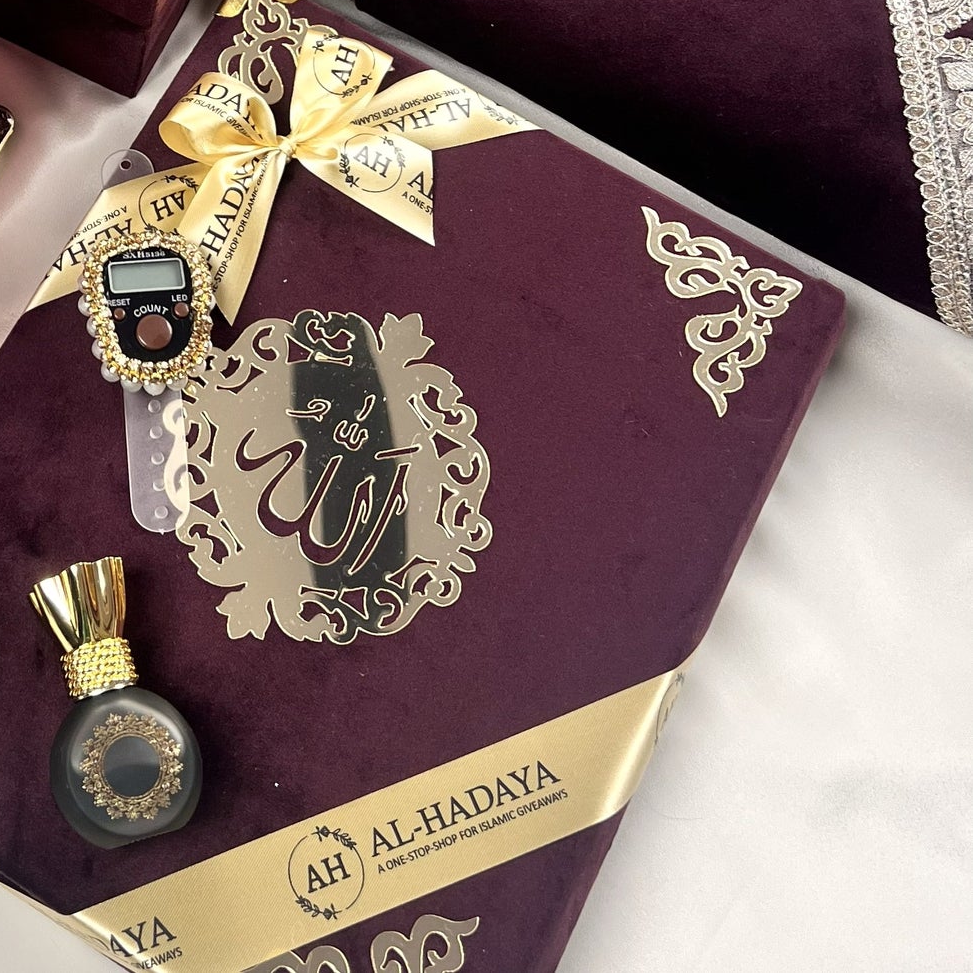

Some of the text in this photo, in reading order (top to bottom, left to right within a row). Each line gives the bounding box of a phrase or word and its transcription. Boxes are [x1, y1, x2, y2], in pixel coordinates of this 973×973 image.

[331, 44, 359, 86] AH
[194, 98, 227, 118] ISLAMIC
[382, 108, 398, 119] FOR
[400, 89, 460, 112] ONE-STOP-SHOP
[353, 146, 392, 178] AH
[150, 190, 187, 222] AH
[401, 191, 408, 199] A
[236, 220, 248, 237] FOR
[244, 186, 259, 220] ISLAMIC
[107, 298, 131, 306] RESET
[133, 304, 169, 317] COUNT
[171, 294, 188, 302] LED
[371, 760, 561, 858] AL-HADAYA
[377, 788, 568, 874] A ONE-STOP-SHOP FOR ISLAMIC GIVEAWAYS
[308, 852, 351, 894] AH
